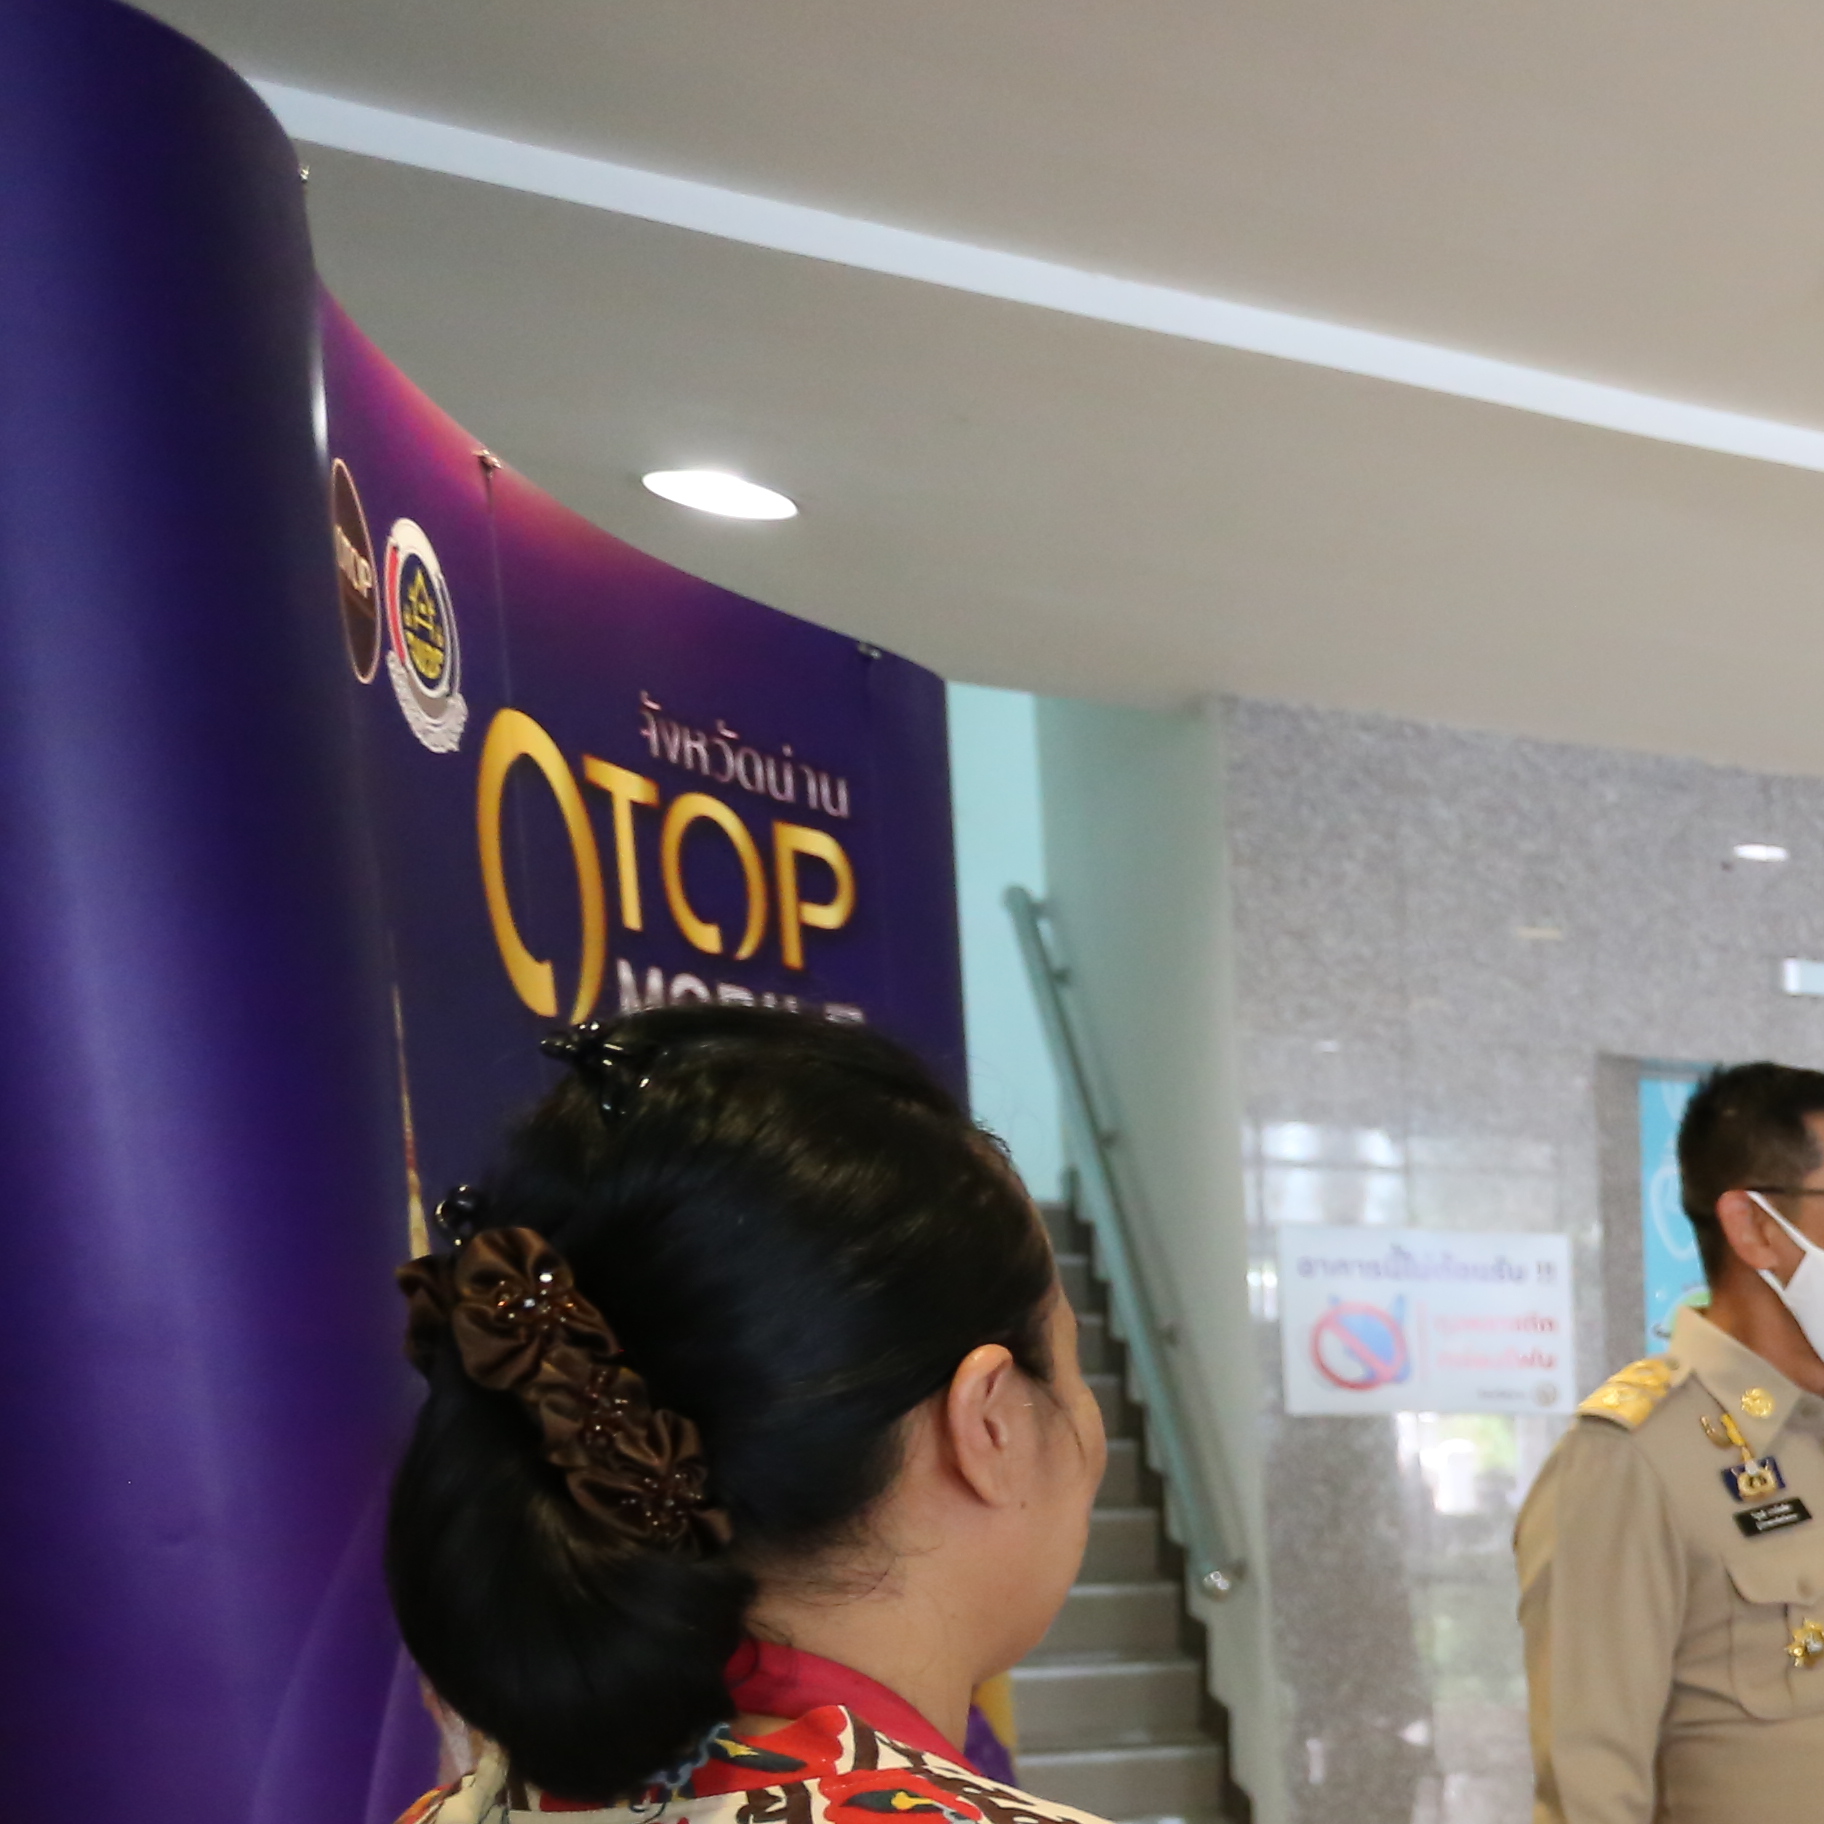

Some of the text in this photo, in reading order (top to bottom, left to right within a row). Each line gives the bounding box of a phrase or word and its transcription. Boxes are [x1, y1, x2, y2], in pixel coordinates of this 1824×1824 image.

[477, 707, 857, 1023] OTOP
[639, 690, 849, 819] จังหวัดน่าน
